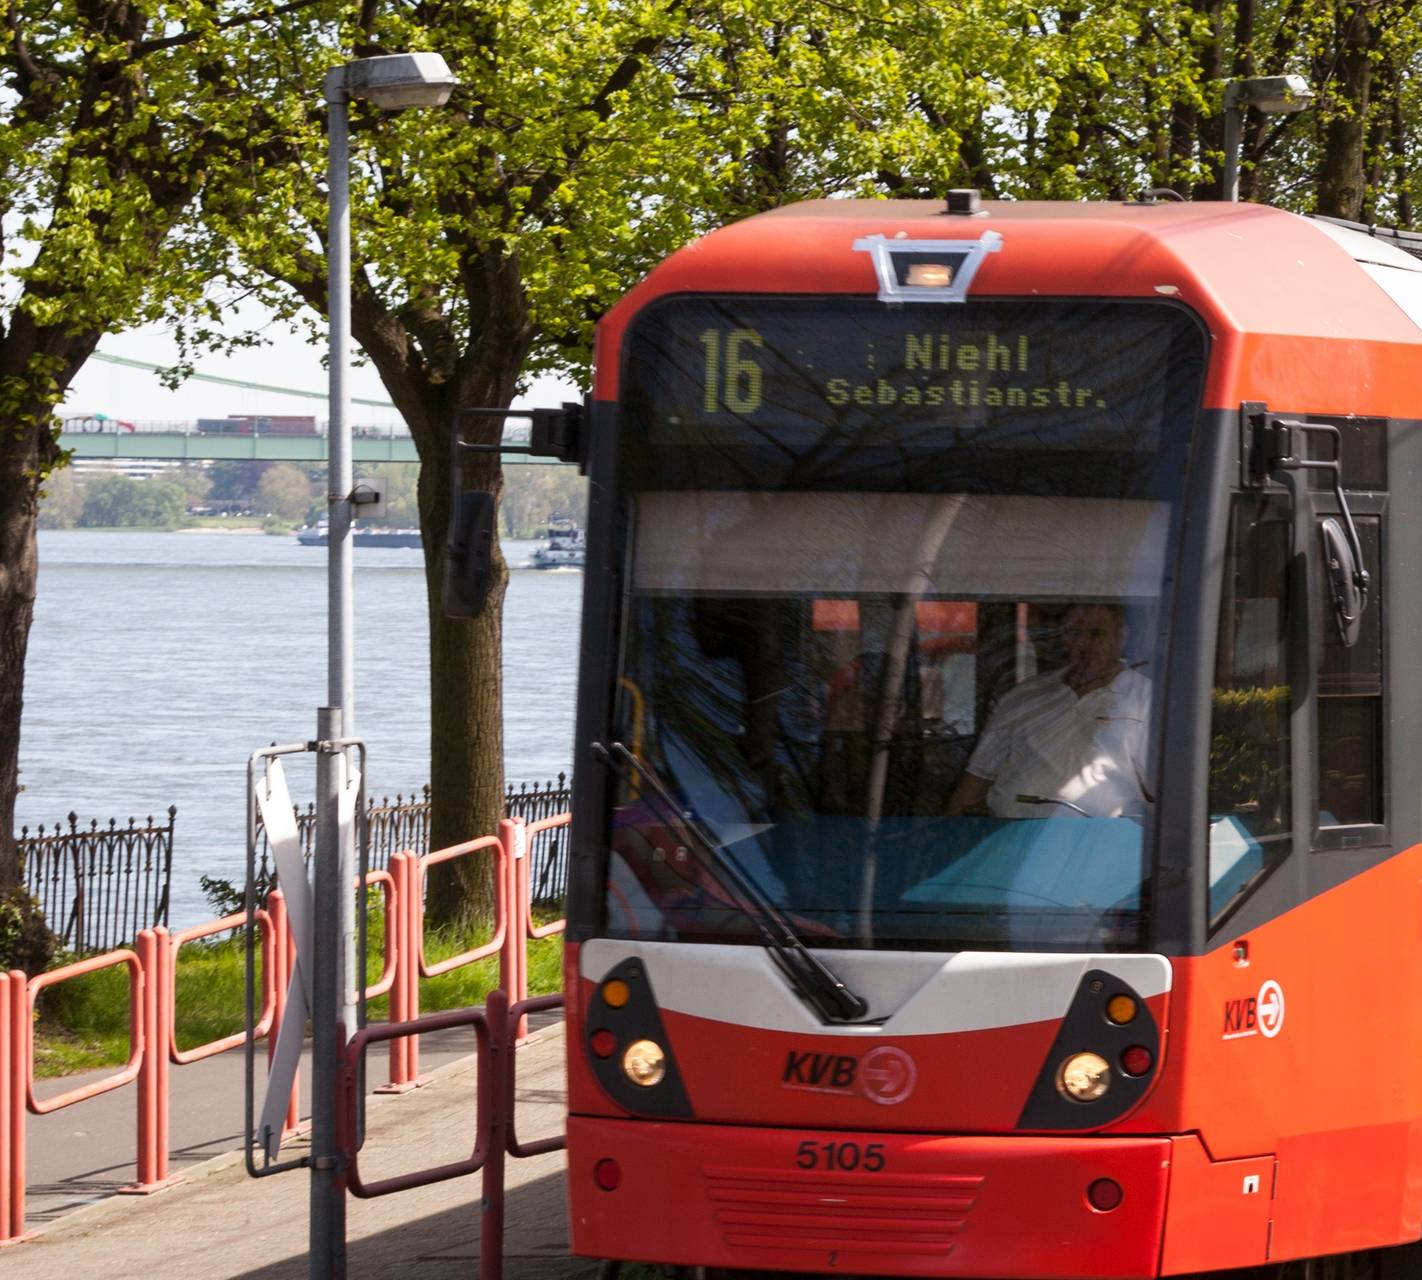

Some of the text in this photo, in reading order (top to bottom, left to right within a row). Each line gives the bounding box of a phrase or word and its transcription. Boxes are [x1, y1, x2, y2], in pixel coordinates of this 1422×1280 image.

[699, 328, 763, 413] 16
[904, 334, 1029, 371] Niehl
[825, 378, 1106, 408] Sebastianstr.
[1224, 997, 1257, 1033] KVB
[783, 1051, 858, 1088] KVB
[796, 1140, 886, 1172] 5105
